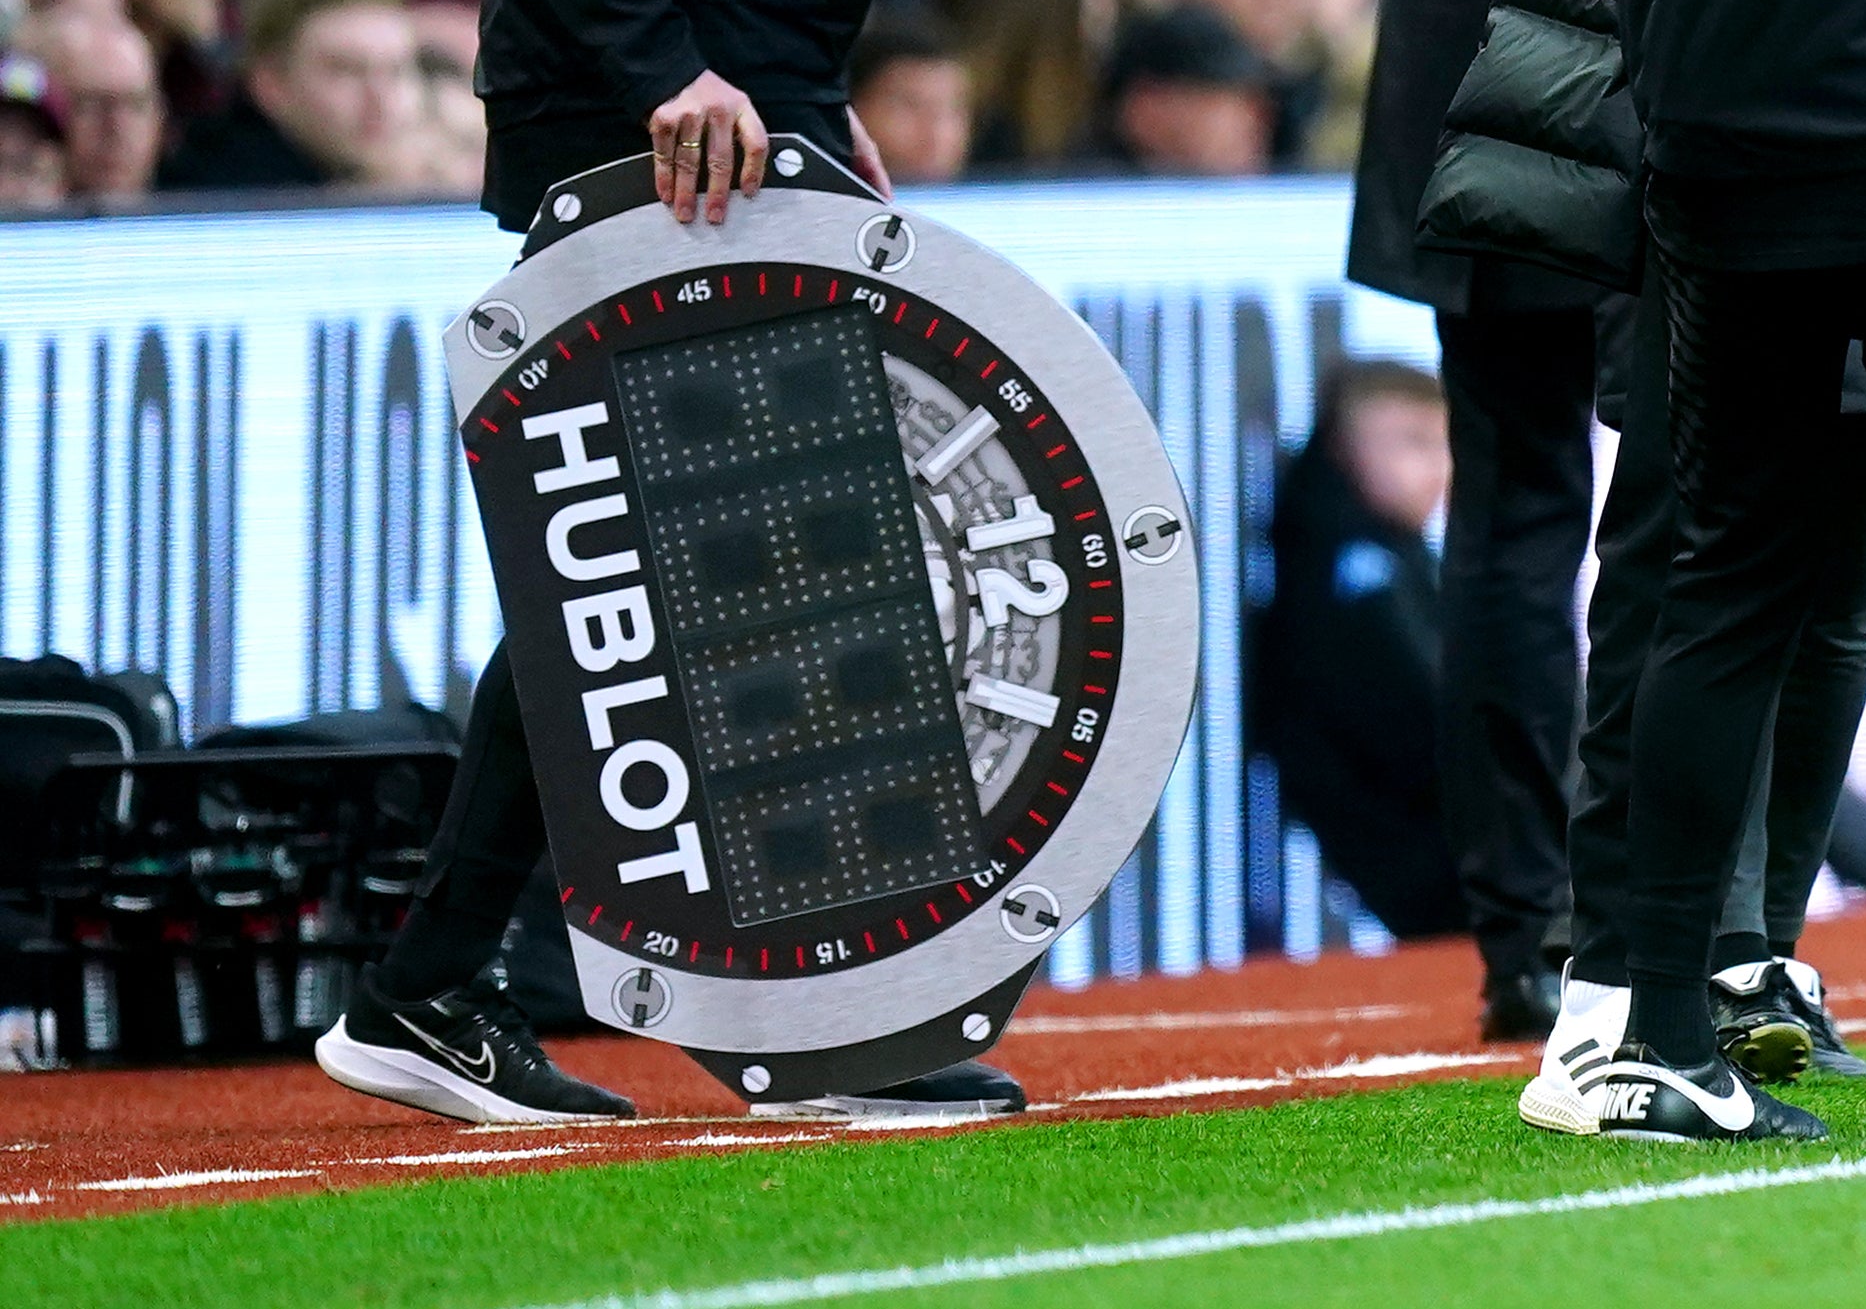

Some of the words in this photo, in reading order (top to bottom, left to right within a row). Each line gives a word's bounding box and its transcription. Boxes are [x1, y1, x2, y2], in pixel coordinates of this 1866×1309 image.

[677, 278, 713, 304] 45
[518, 358, 548, 390] 40
[998, 378, 1034, 414] 55
[966, 494, 1070, 627] 12
[1081, 533, 1108, 569] 60
[521, 401, 711, 894] HUBLOT
[1071, 707, 1100, 744] 05
[642, 930, 680, 957] 20
[815, 938, 852, 964] 15
